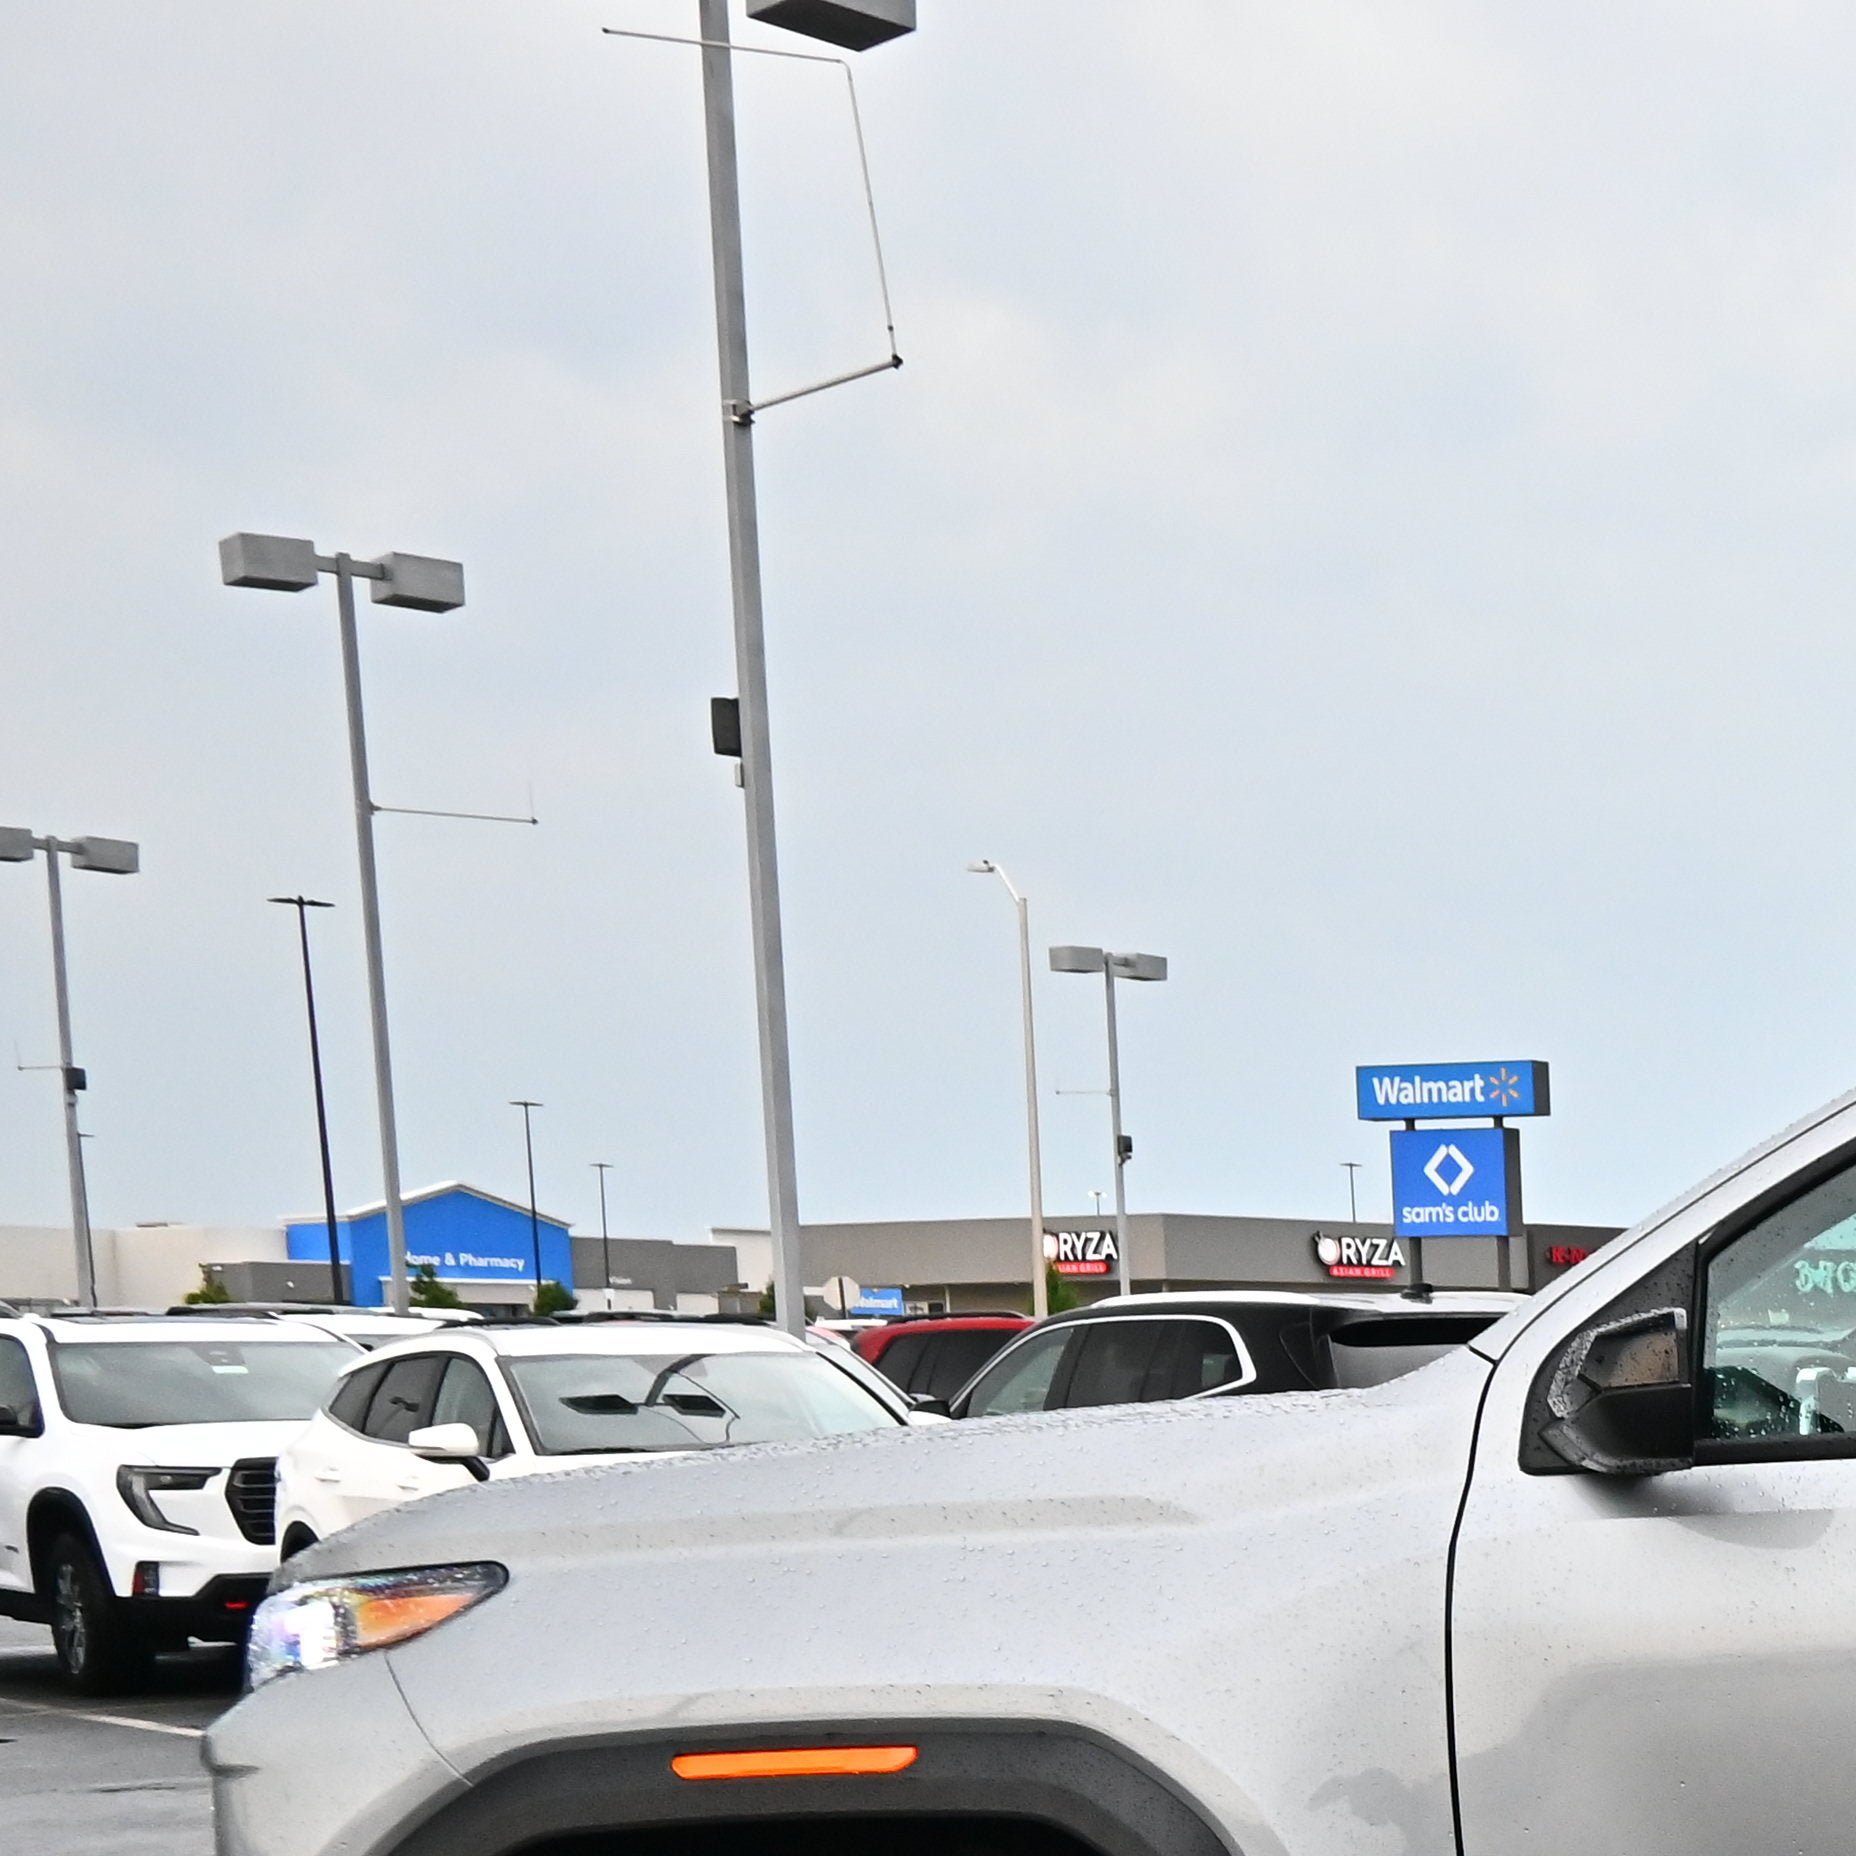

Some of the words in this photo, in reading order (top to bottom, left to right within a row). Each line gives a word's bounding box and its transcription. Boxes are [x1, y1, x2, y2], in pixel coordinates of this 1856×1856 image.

[1372, 1074, 1485, 1105] Walmart
[1402, 1202, 1454, 1224] sam's
[1457, 1200, 1500, 1222] club
[444, 1252, 456, 1266] &
[459, 1253, 525, 1272] Pharmacy
